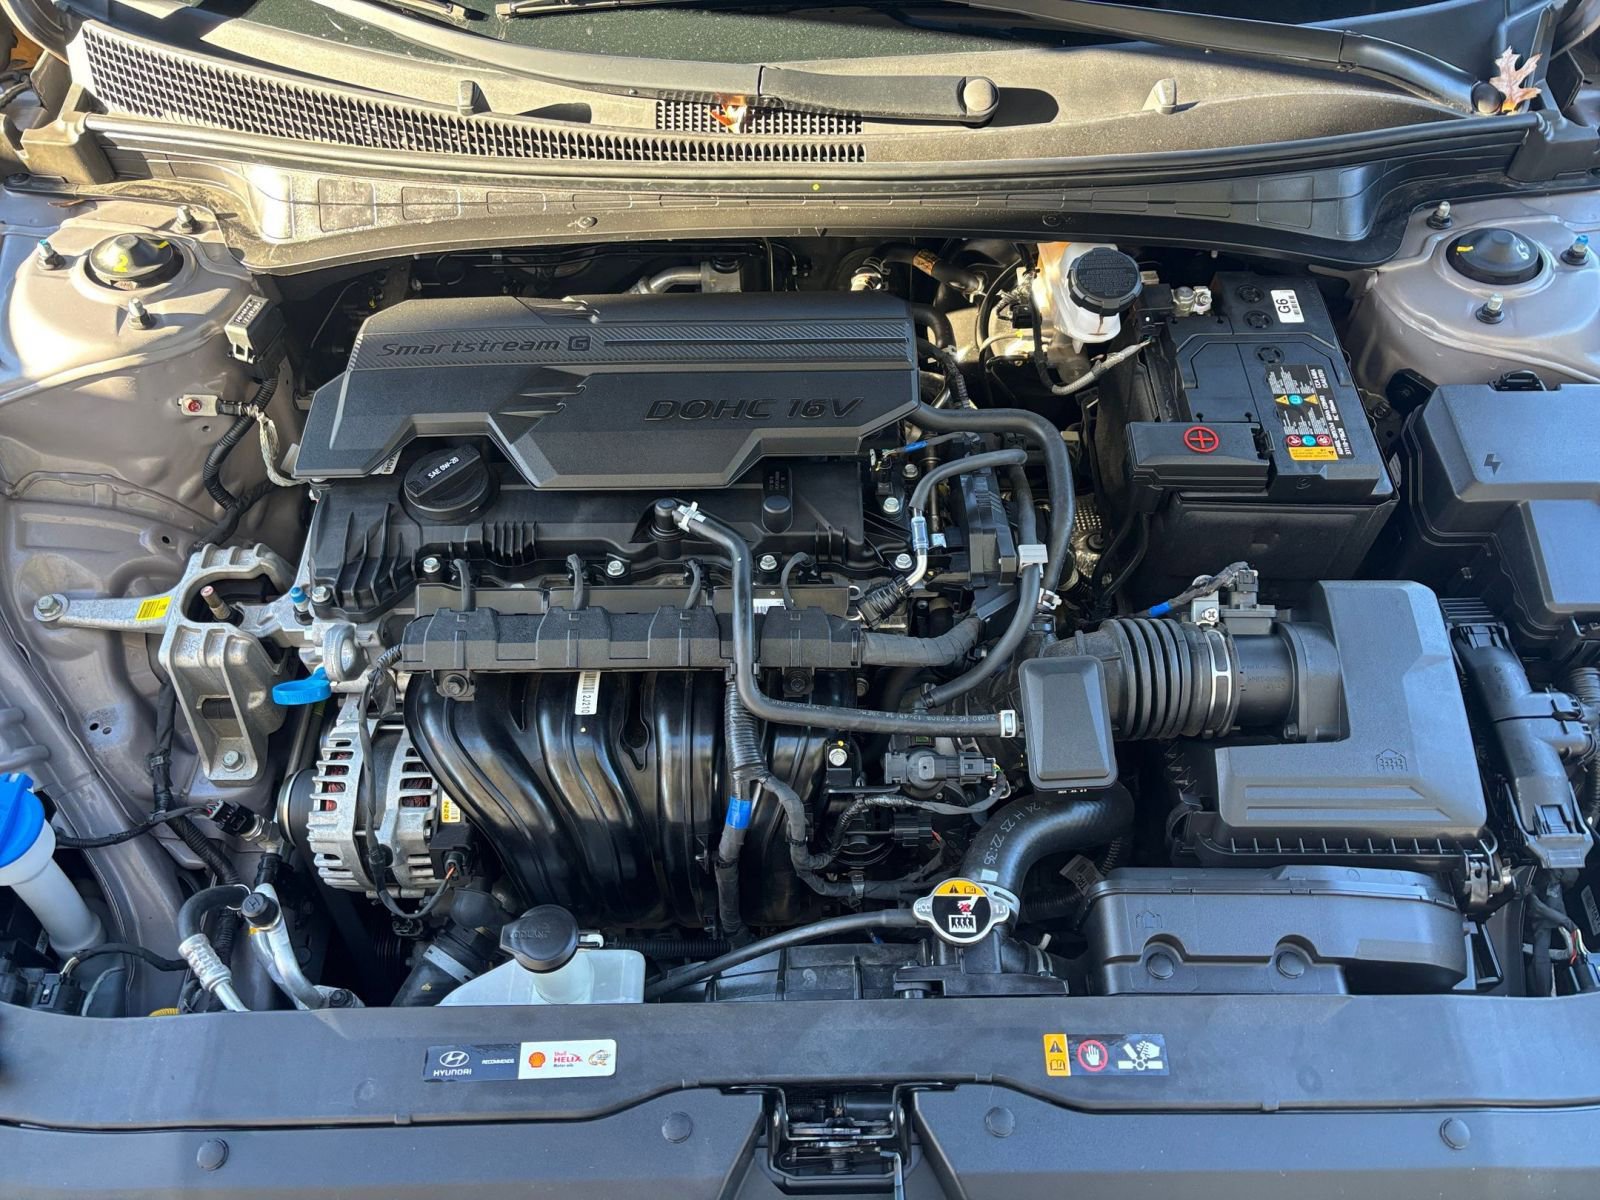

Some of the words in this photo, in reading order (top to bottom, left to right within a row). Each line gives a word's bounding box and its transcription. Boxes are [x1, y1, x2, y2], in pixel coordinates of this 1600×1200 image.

[113, 255, 129, 273] 2
[1277, 298, 1291, 314] G6
[376, 340, 561, 357] Smartstream
[644, 398, 777, 421] DOHC
[787, 397, 865, 420] 16V
[427, 467, 442, 479] SAE
[440, 456, 460, 471] 0W-20
[1000, 819, 1016, 833] 23
[553, 1055, 583, 1063] HELIX
[433, 1068, 472, 1077] HYUNDAI
